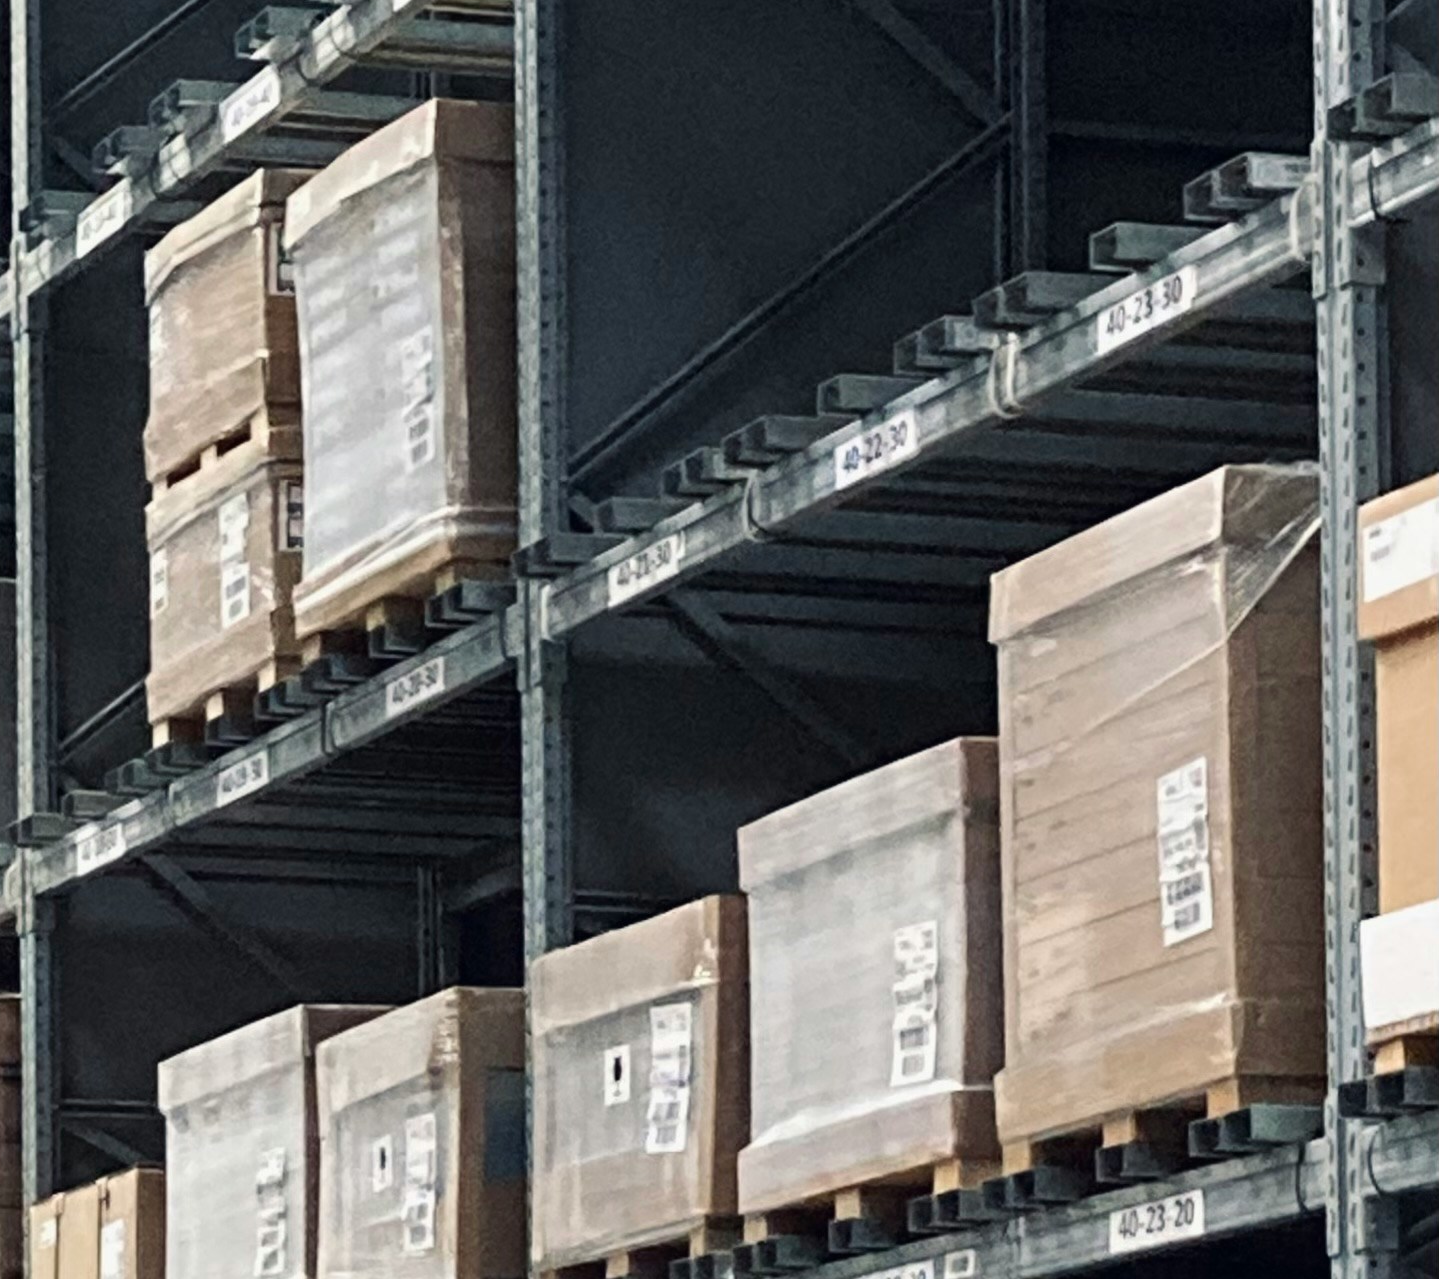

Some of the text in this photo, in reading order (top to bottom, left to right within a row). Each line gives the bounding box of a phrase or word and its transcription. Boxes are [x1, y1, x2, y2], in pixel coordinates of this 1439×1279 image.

[1106, 274, 1183, 335] 40-23-30
[842, 420, 908, 473] 40-22-30
[1119, 1198, 1195, 1239] 40-23-20
